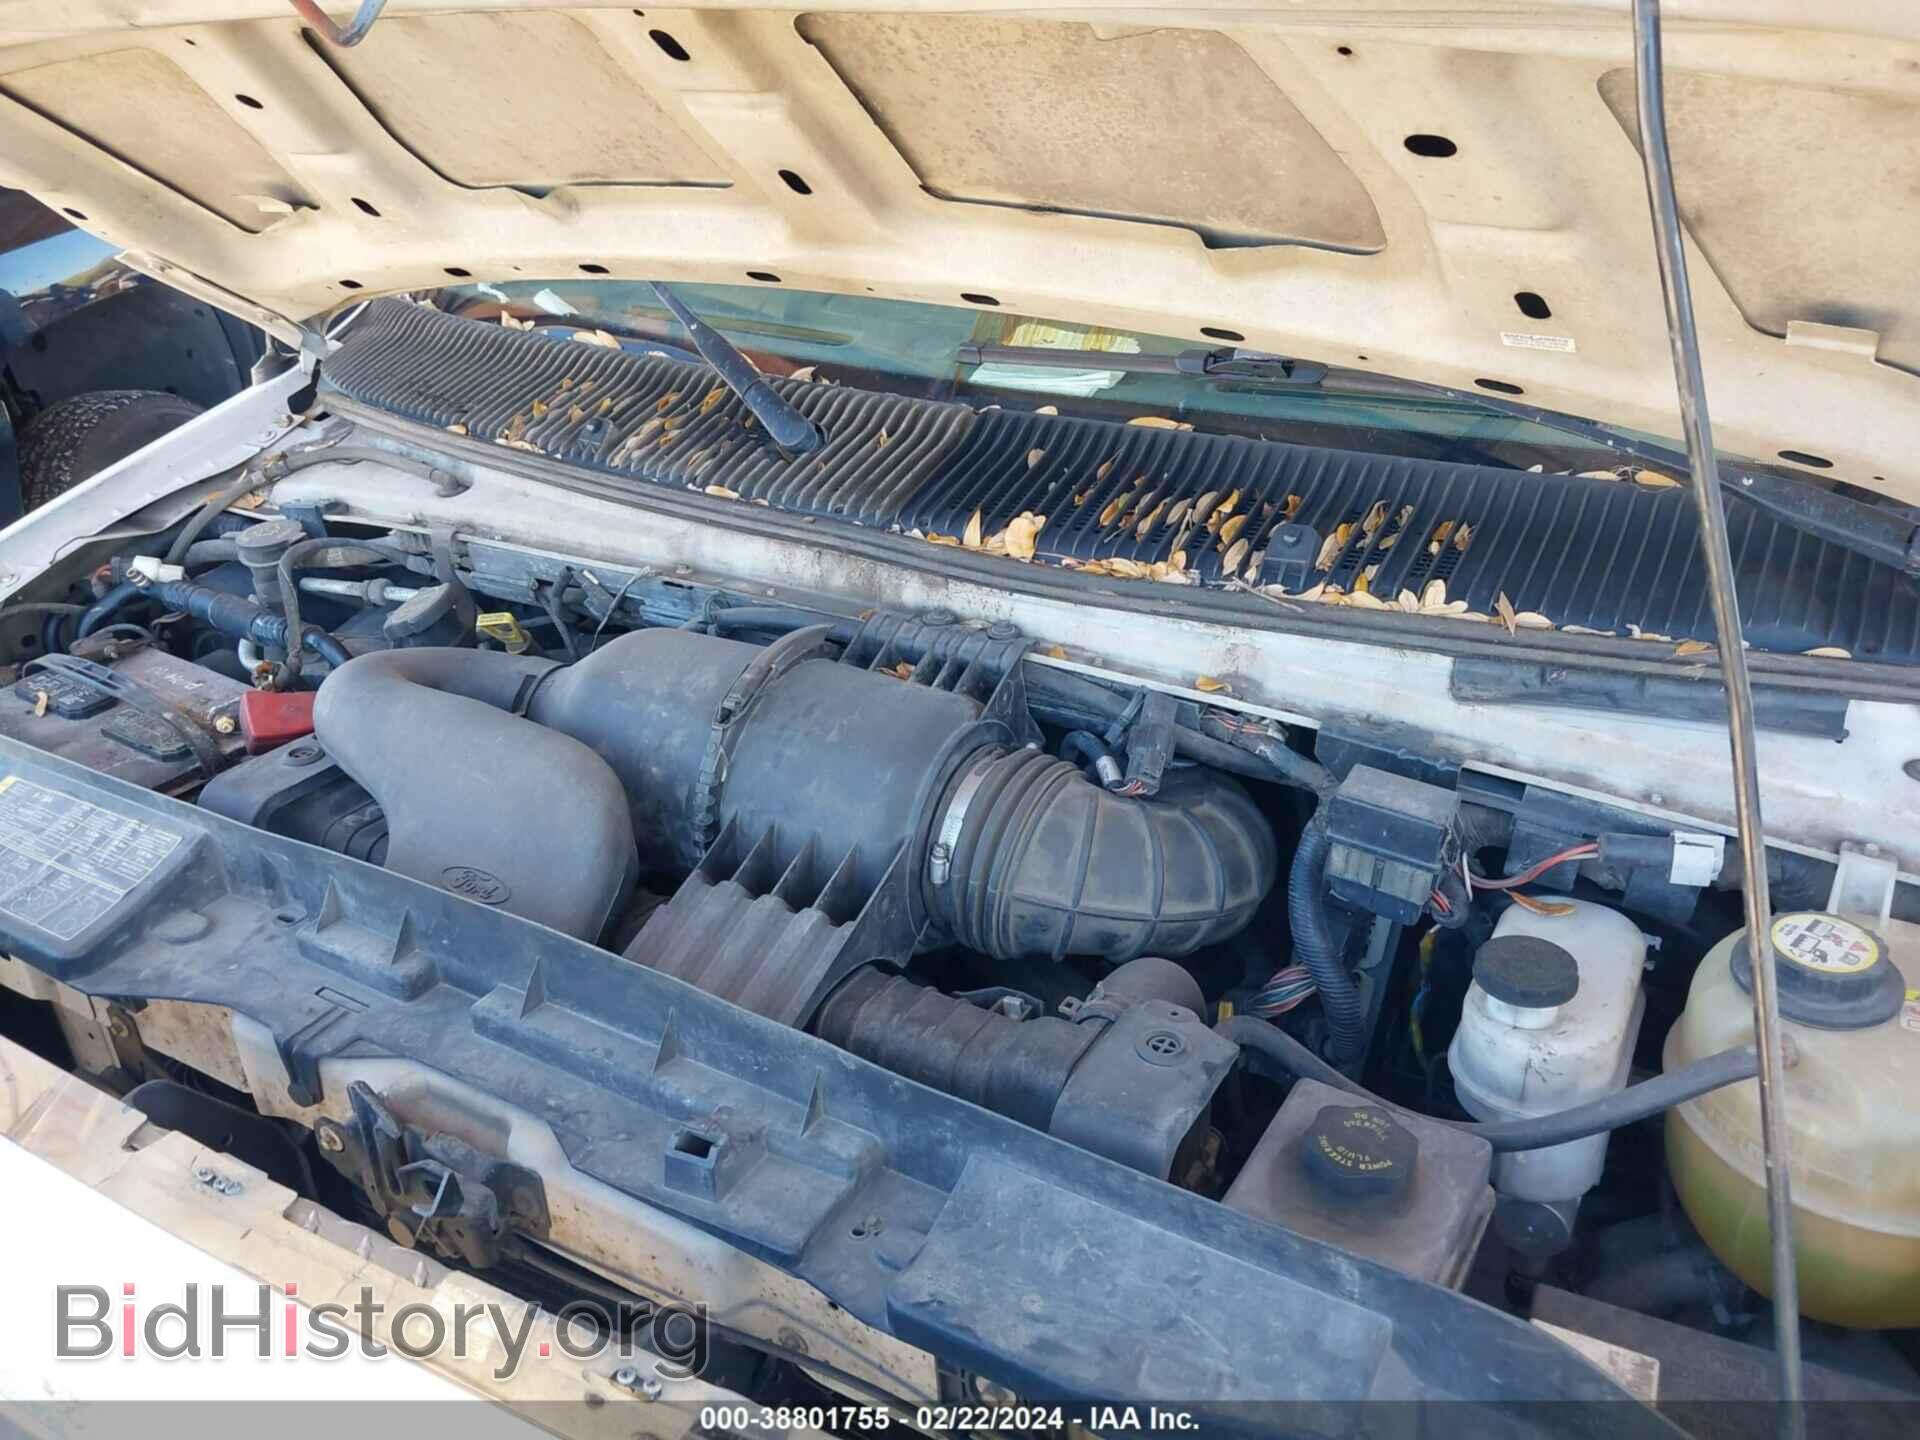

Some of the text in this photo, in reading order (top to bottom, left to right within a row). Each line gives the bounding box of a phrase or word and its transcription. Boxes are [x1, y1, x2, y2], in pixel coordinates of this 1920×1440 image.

[453, 870, 499, 899] Ford
[1353, 1111, 1368, 1120] DO
[1359, 1159, 1393, 1171] POWER
